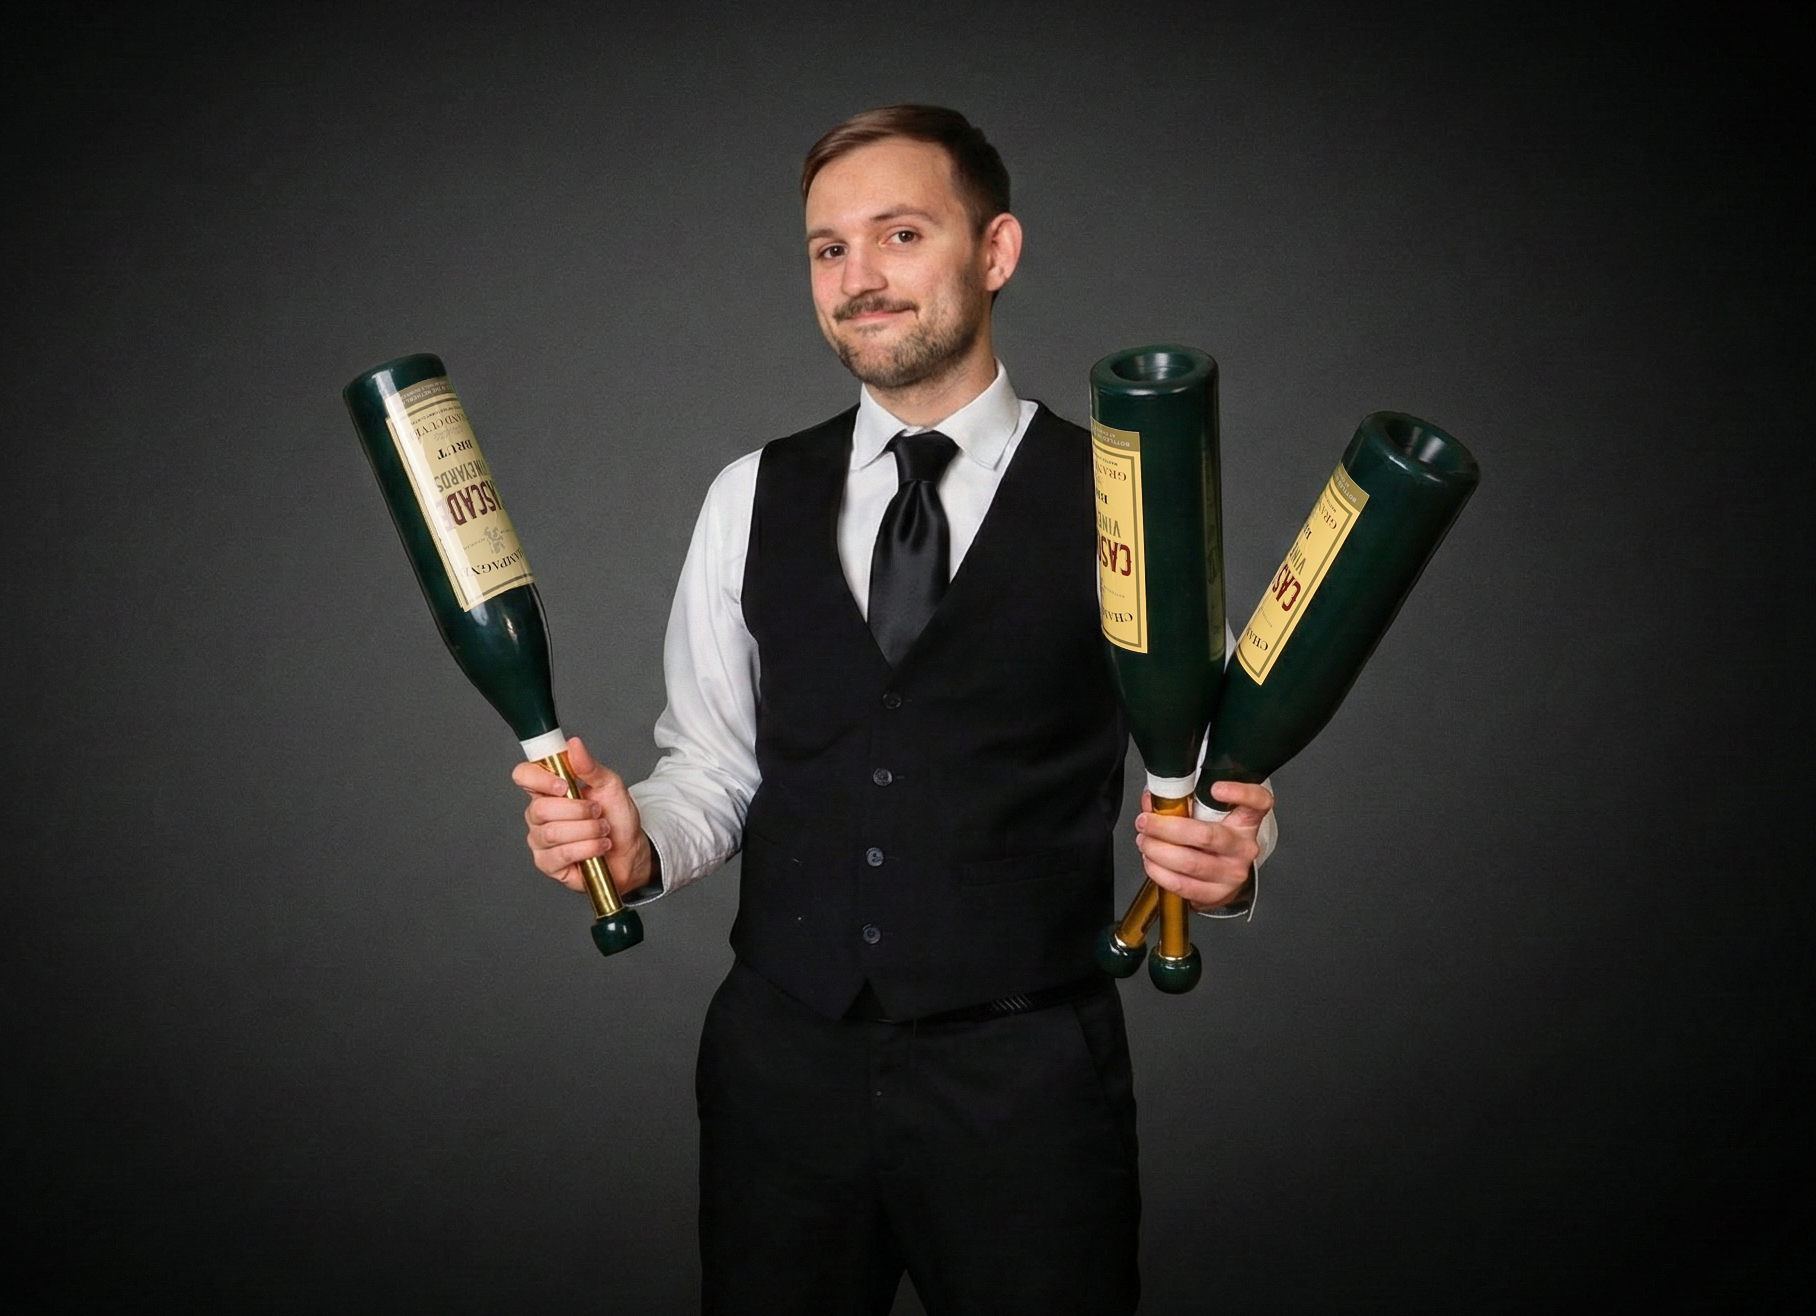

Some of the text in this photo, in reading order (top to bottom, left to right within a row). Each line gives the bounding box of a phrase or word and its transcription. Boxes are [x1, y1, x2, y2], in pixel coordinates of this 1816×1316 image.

[444, 413, 466, 425] RAND
[436, 439, 473, 460] BRUT
[1102, 435, 1131, 447] BOTTLED
[1095, 461, 1127, 481] GRAN
[1338, 480, 1357, 504] BOTTLED
[435, 480, 502, 532] ASCADE
[1097, 511, 1121, 538] VINE
[461, 547, 524, 577] HAMPAGNE
[1099, 535, 1132, 577] CAS
[1289, 542, 1307, 576] VINE
[1271, 563, 1302, 612] CAS
[1102, 607, 1134, 623] CHAM
